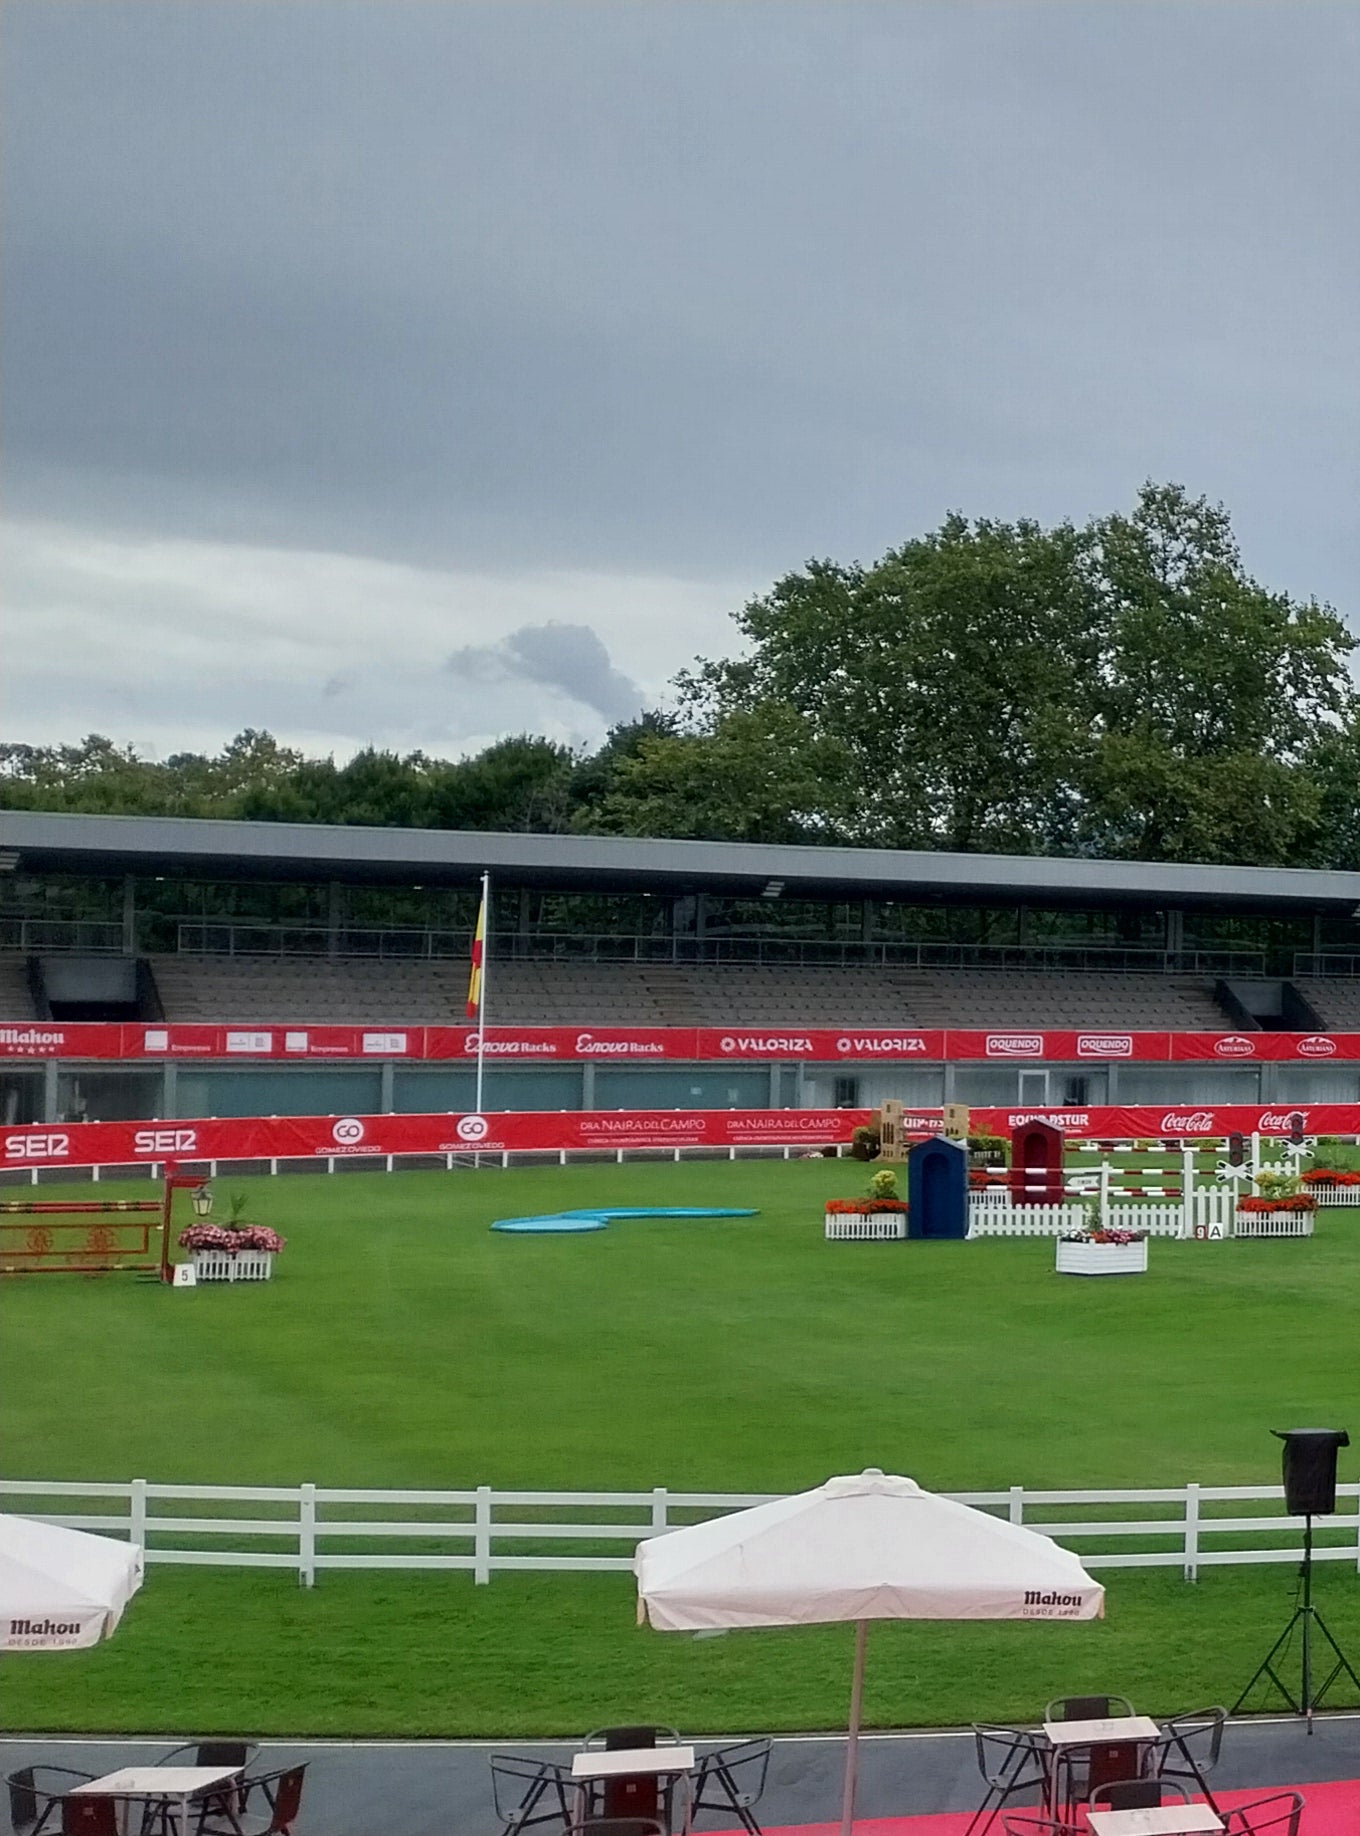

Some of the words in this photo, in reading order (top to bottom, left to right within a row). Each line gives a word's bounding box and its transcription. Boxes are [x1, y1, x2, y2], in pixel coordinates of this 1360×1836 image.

[0, 1028, 64, 1045] Mahou
[521, 1042, 556, 1053] Racks
[630, 1042, 664, 1053] Racks
[737, 1037, 813, 1051] VALORIZA
[853, 1037, 926, 1051] VALORIZA
[989, 1039, 1039, 1050] OQUENDO
[1081, 1039, 1129, 1050] OQUENDO
[601, 1120, 644, 1130] NAIRA
[660, 1119, 706, 1130] CAMPO
[745, 1118, 784, 1129] NAIRA
[799, 1117, 841, 1129] CAMPO
[5, 1133, 69, 1158] SER
[134, 1129, 196, 1153] SER
[1210, 1226, 1221, 1237] A
[181, 1269, 188, 1281] 5
[1024, 1591, 1082, 1606] Mahou
[10, 1619, 81, 1635] Mahou
